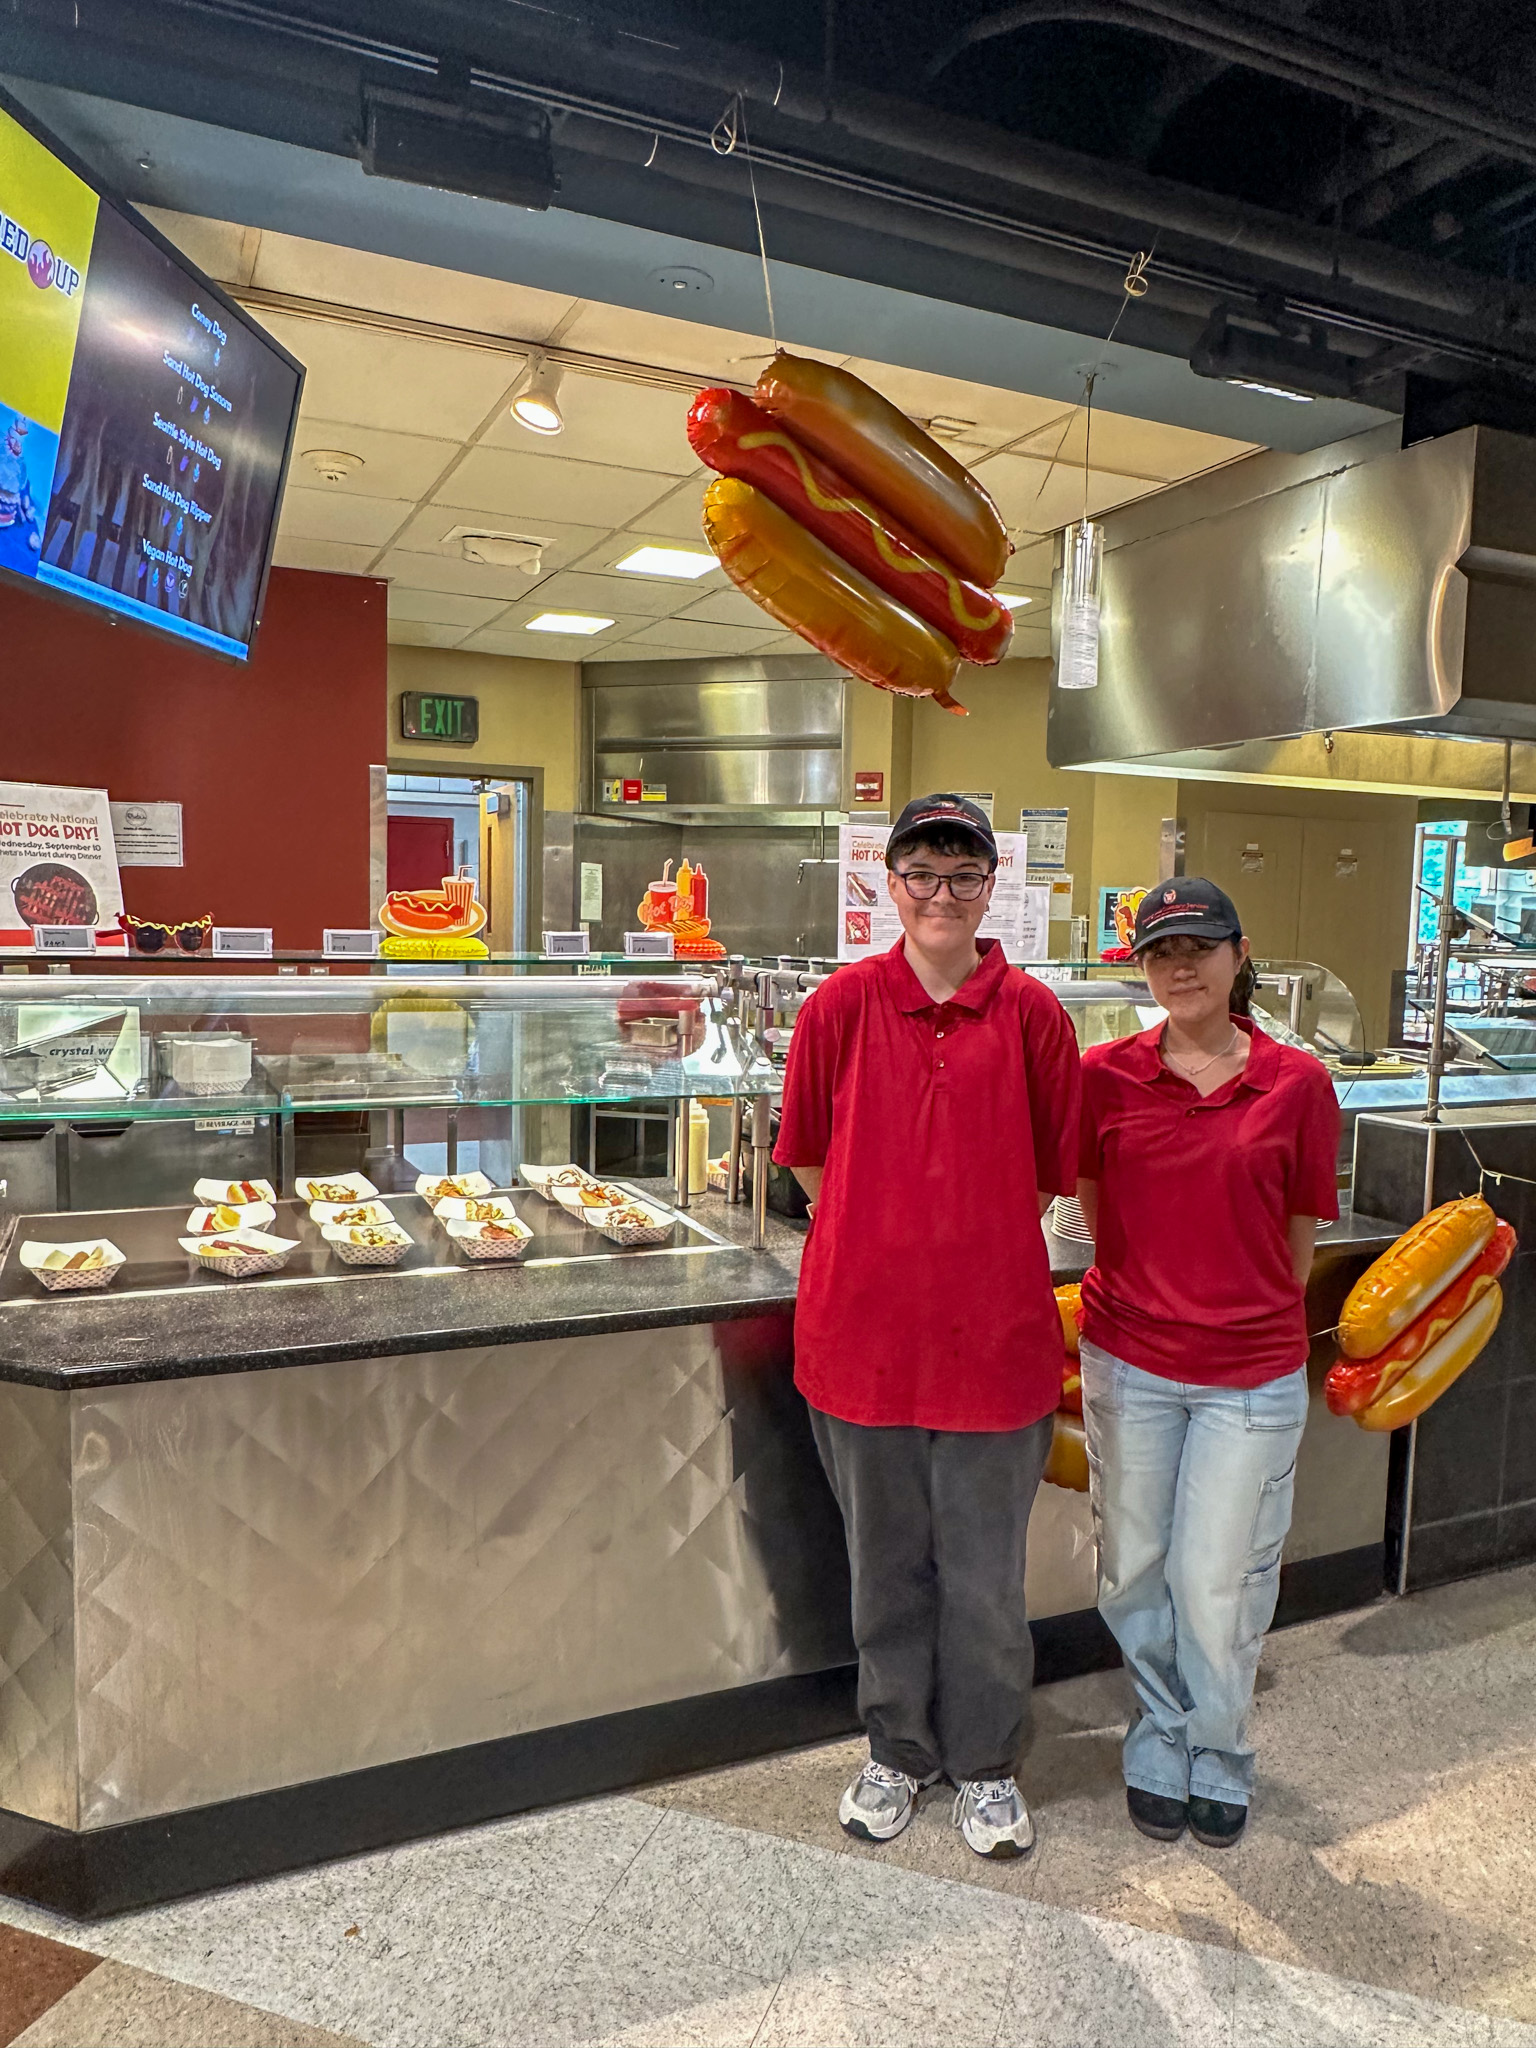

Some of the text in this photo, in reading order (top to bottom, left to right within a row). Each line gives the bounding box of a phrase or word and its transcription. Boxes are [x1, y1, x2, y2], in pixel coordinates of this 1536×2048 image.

[0, 213, 80, 296] ED UP
[191, 303, 228, 346] Coney Dog
[163, 349, 183, 375] Sand
[182, 363, 195, 384] Hot
[194, 373, 210, 398] Dog
[153, 411, 222, 471] Seattle Style Hot Dog
[142, 473, 212, 524] Sand Hot Dog Ripper
[142, 538, 193, 578] Vegan Hot Dog
[421, 698, 465, 735] EXIT
[0, 809, 99, 825] elebrate National
[0, 821, 99, 841] OT DOG DAY!
[0, 840, 101, 852] ednesday, September 10
[24, 850, 51, 859] Market
[52, 851, 77, 861] during
[77, 852, 102, 861] Dinner
[852, 849, 1014, 868] HOT DO AY!
[643, 901, 667, 922] Hot
[50, 1045, 94, 1057] crystal
